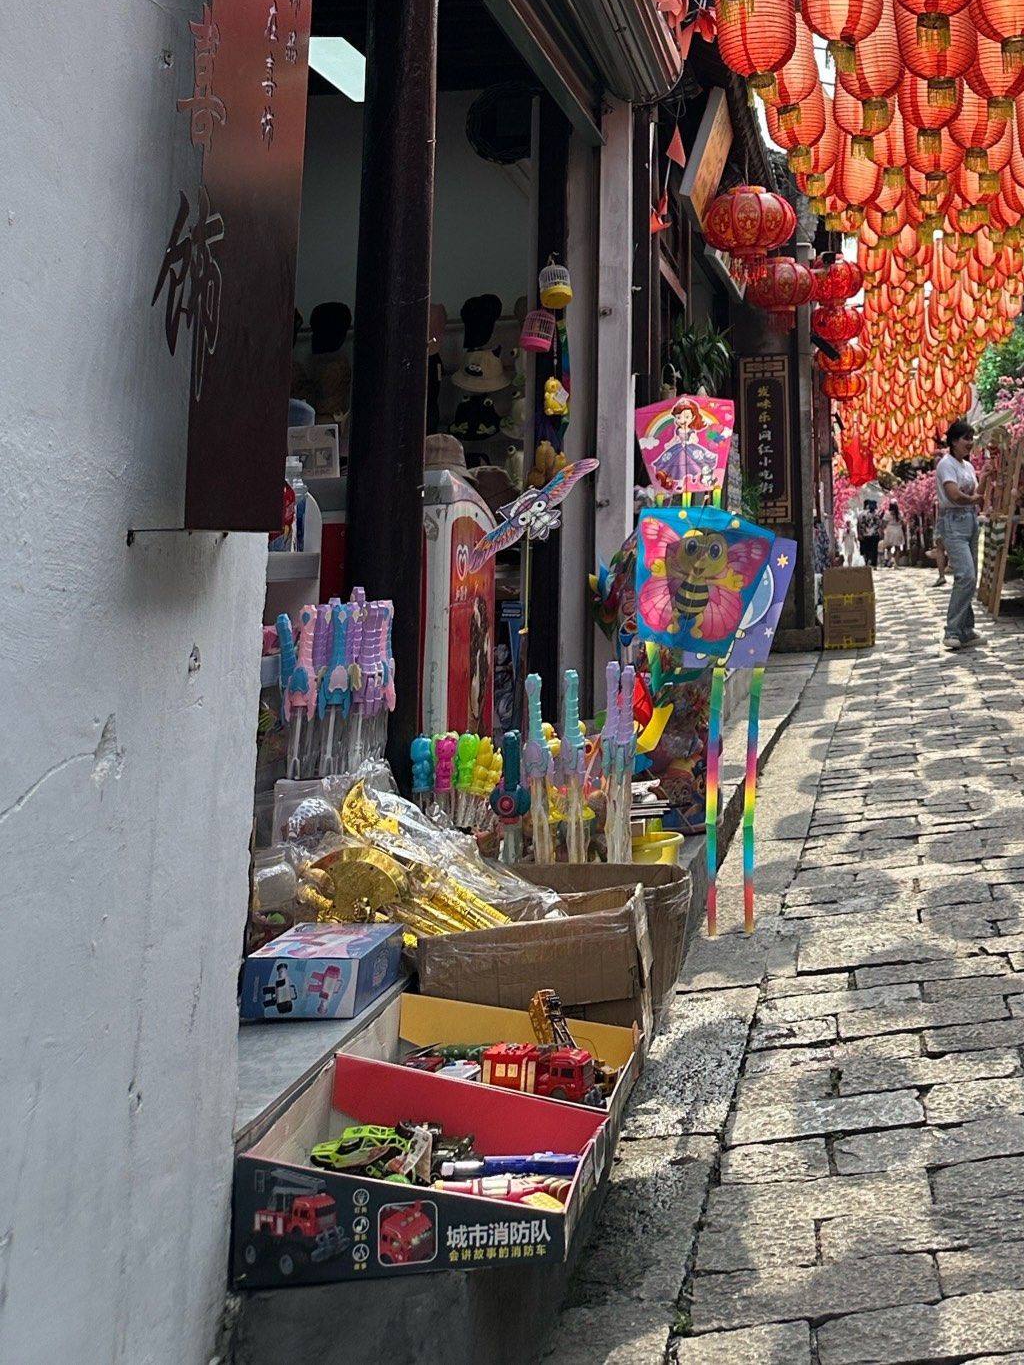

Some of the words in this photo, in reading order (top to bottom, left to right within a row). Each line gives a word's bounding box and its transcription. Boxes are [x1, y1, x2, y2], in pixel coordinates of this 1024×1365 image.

[150, 2, 228, 402] 喜饰
[446, 1219, 552, 1249] 城市消防队
[449, 1244, 547, 1262] 会讲故事的消防车
